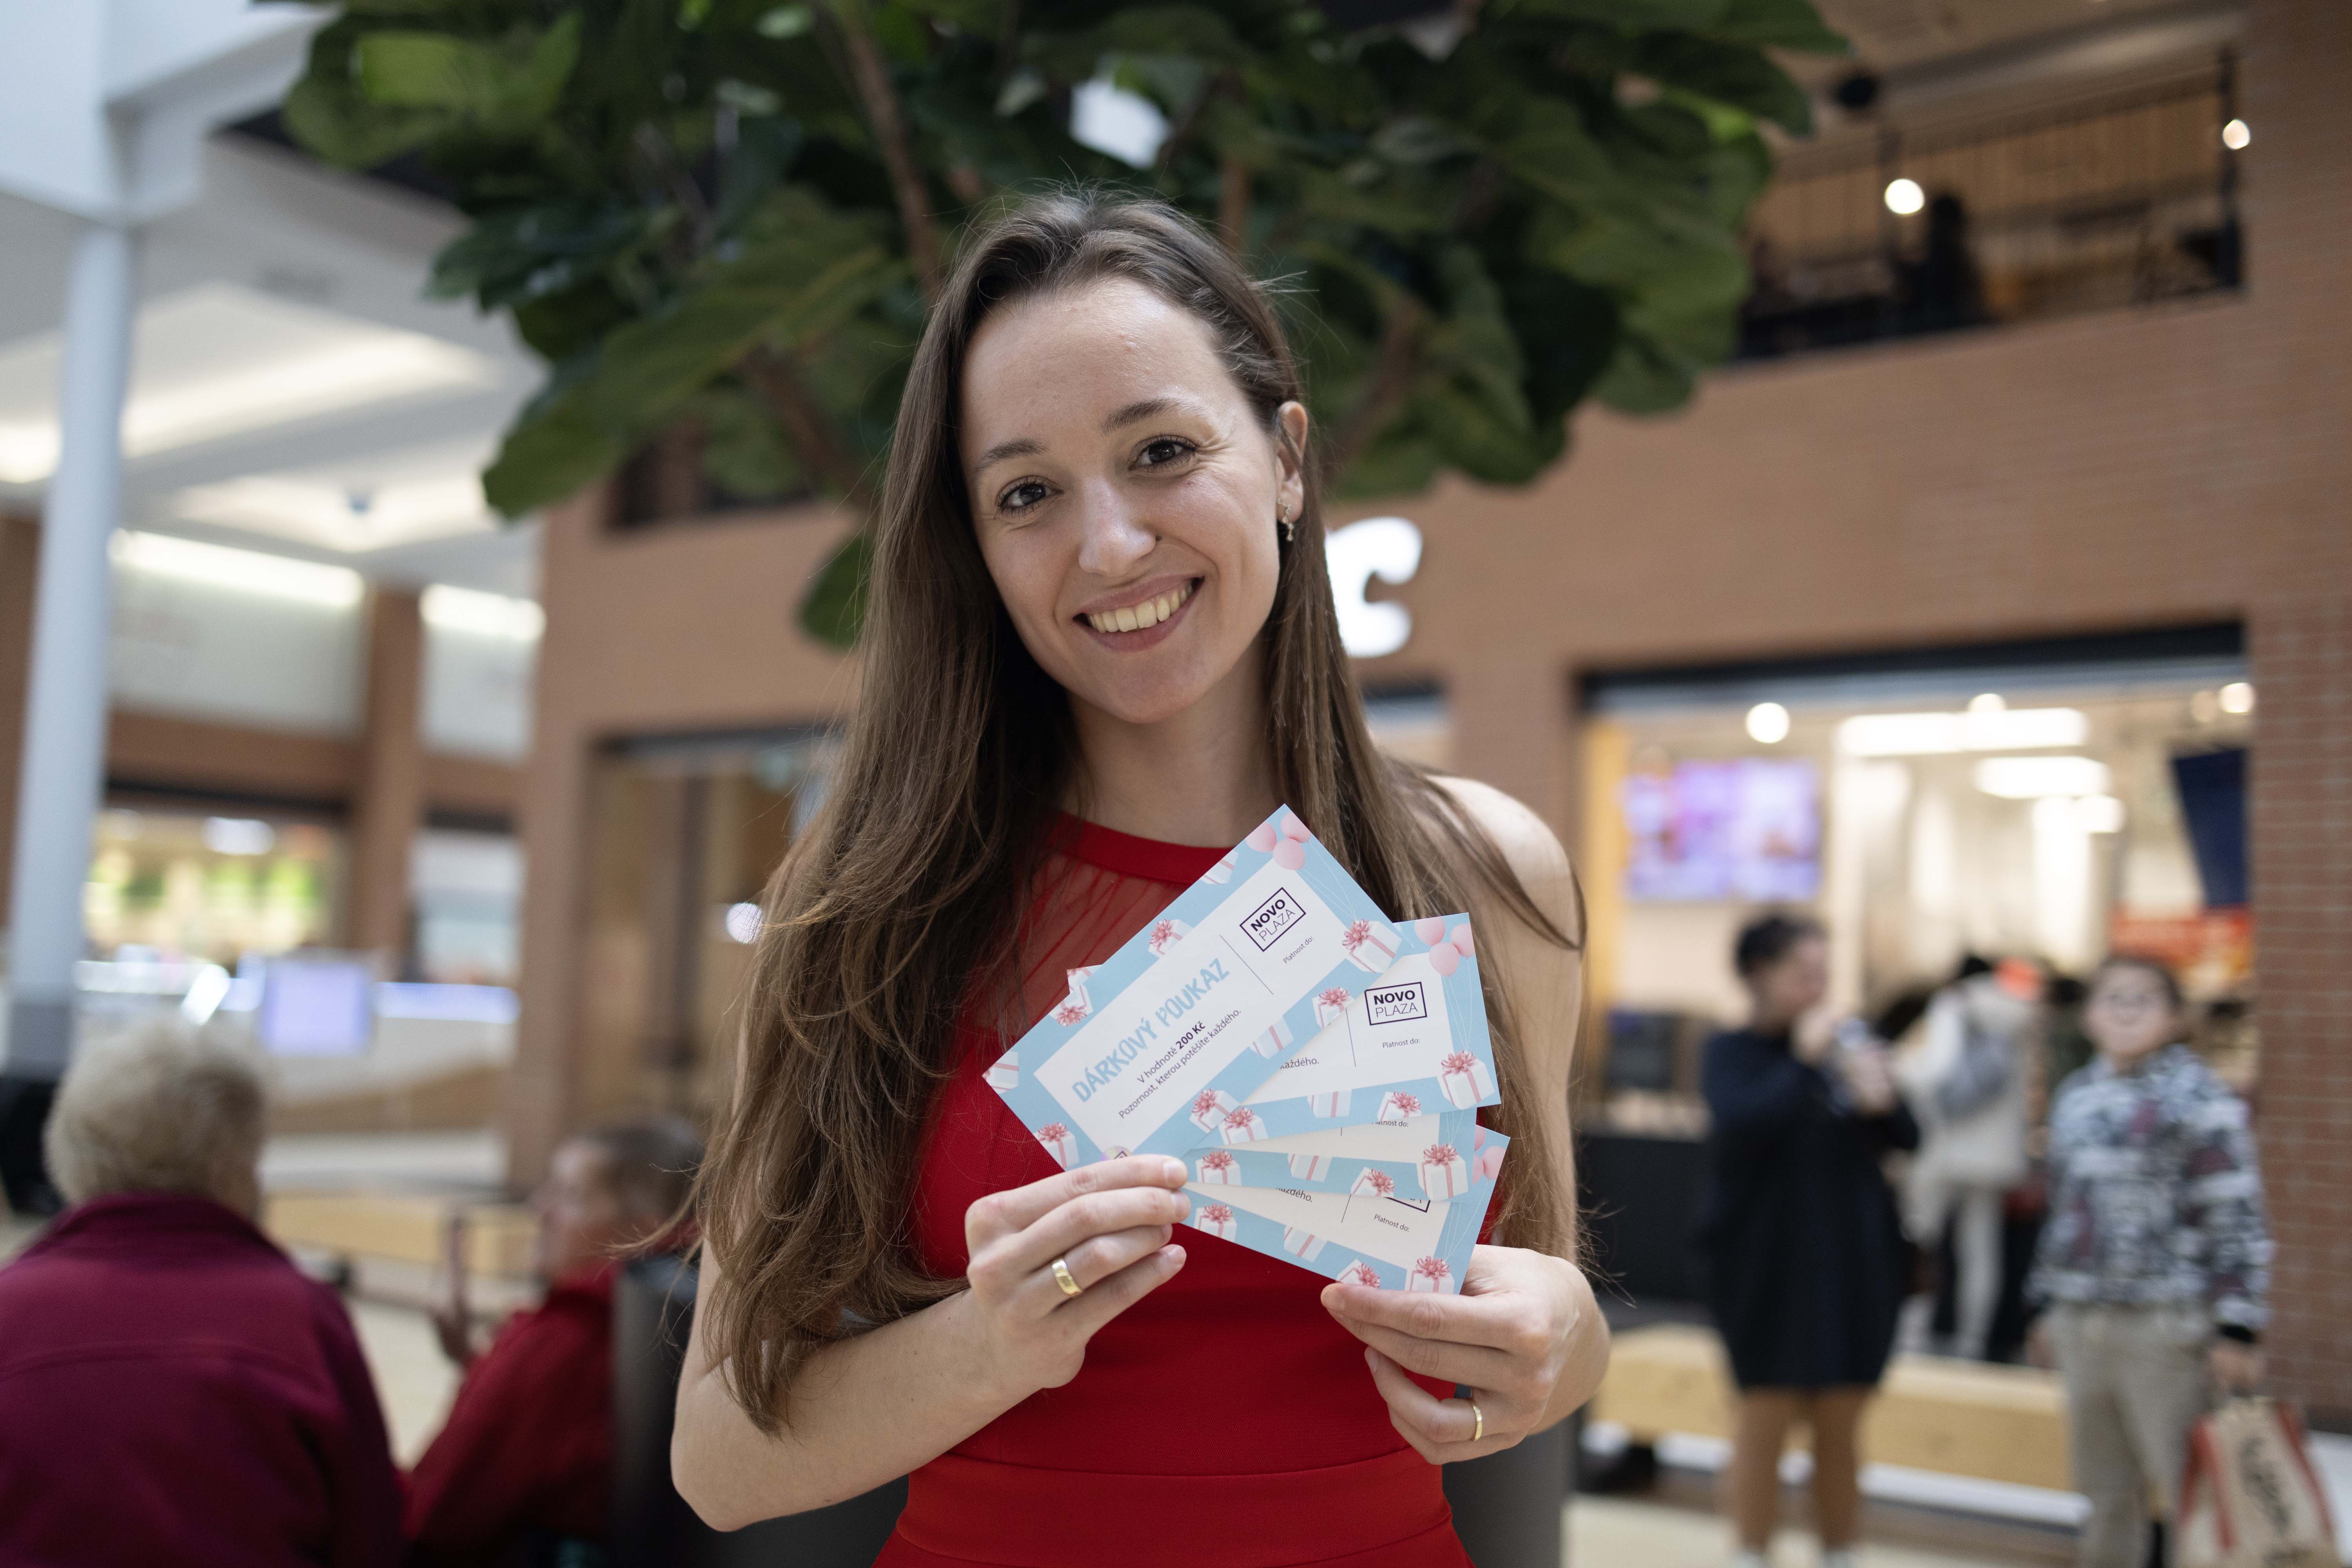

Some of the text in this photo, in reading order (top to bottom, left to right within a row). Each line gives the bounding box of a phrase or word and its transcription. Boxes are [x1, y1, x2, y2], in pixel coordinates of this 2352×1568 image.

[1251, 899, 1285, 931] NOVO
[1259, 909, 1295, 941] PLAZA
[1283, 936, 1314, 964] Platnost do:
[1374, 990, 1415, 1005] NOVO
[1376, 1002, 1417, 1017] PLAZA
[1072, 958, 1230, 1102] DÁRKOVÝ POUKAZ
[1383, 1039, 1408, 1049] Platnost
[1119, 1009, 1241, 1118] Pozornost, kterou potěšíte každého.
[1137, 1021, 1205, 1083] V hodnotě 200 Kč
[1374, 1214, 1410, 1232] Platnost do:
